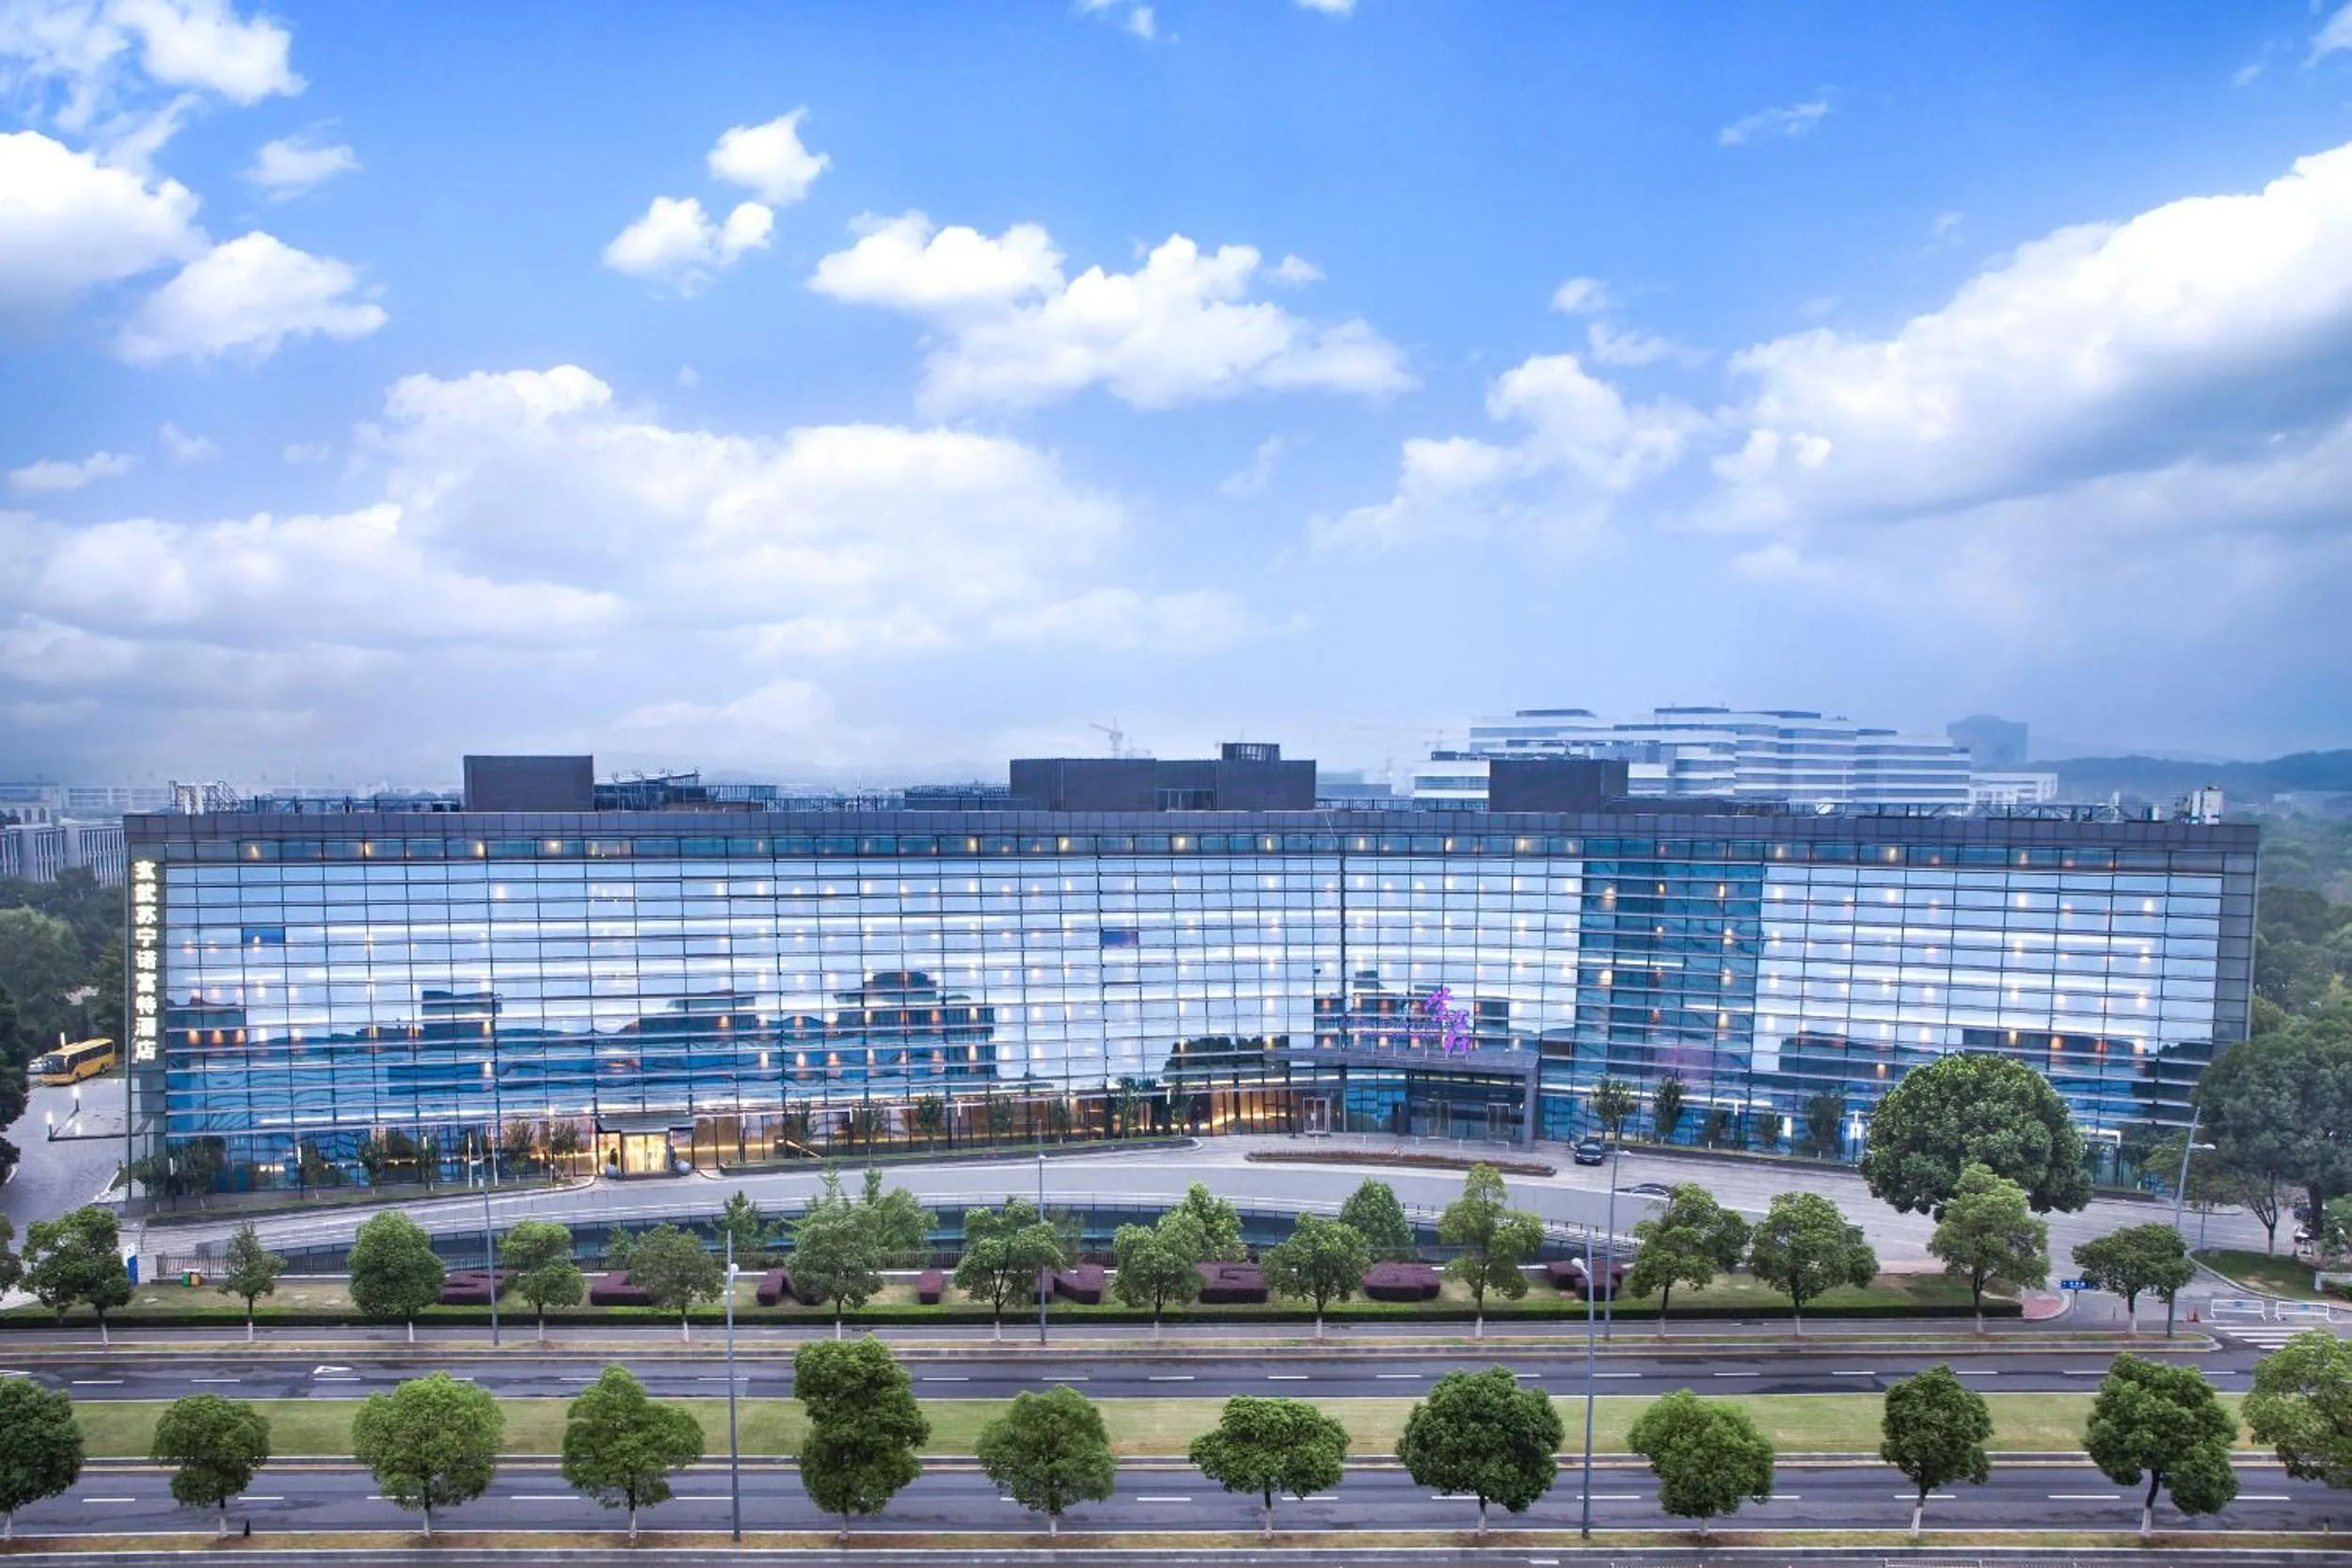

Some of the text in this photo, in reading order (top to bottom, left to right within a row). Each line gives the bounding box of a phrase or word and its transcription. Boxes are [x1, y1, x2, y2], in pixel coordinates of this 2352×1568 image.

[135, 861, 157, 1060] 玄武苏宁诺富特酒店
